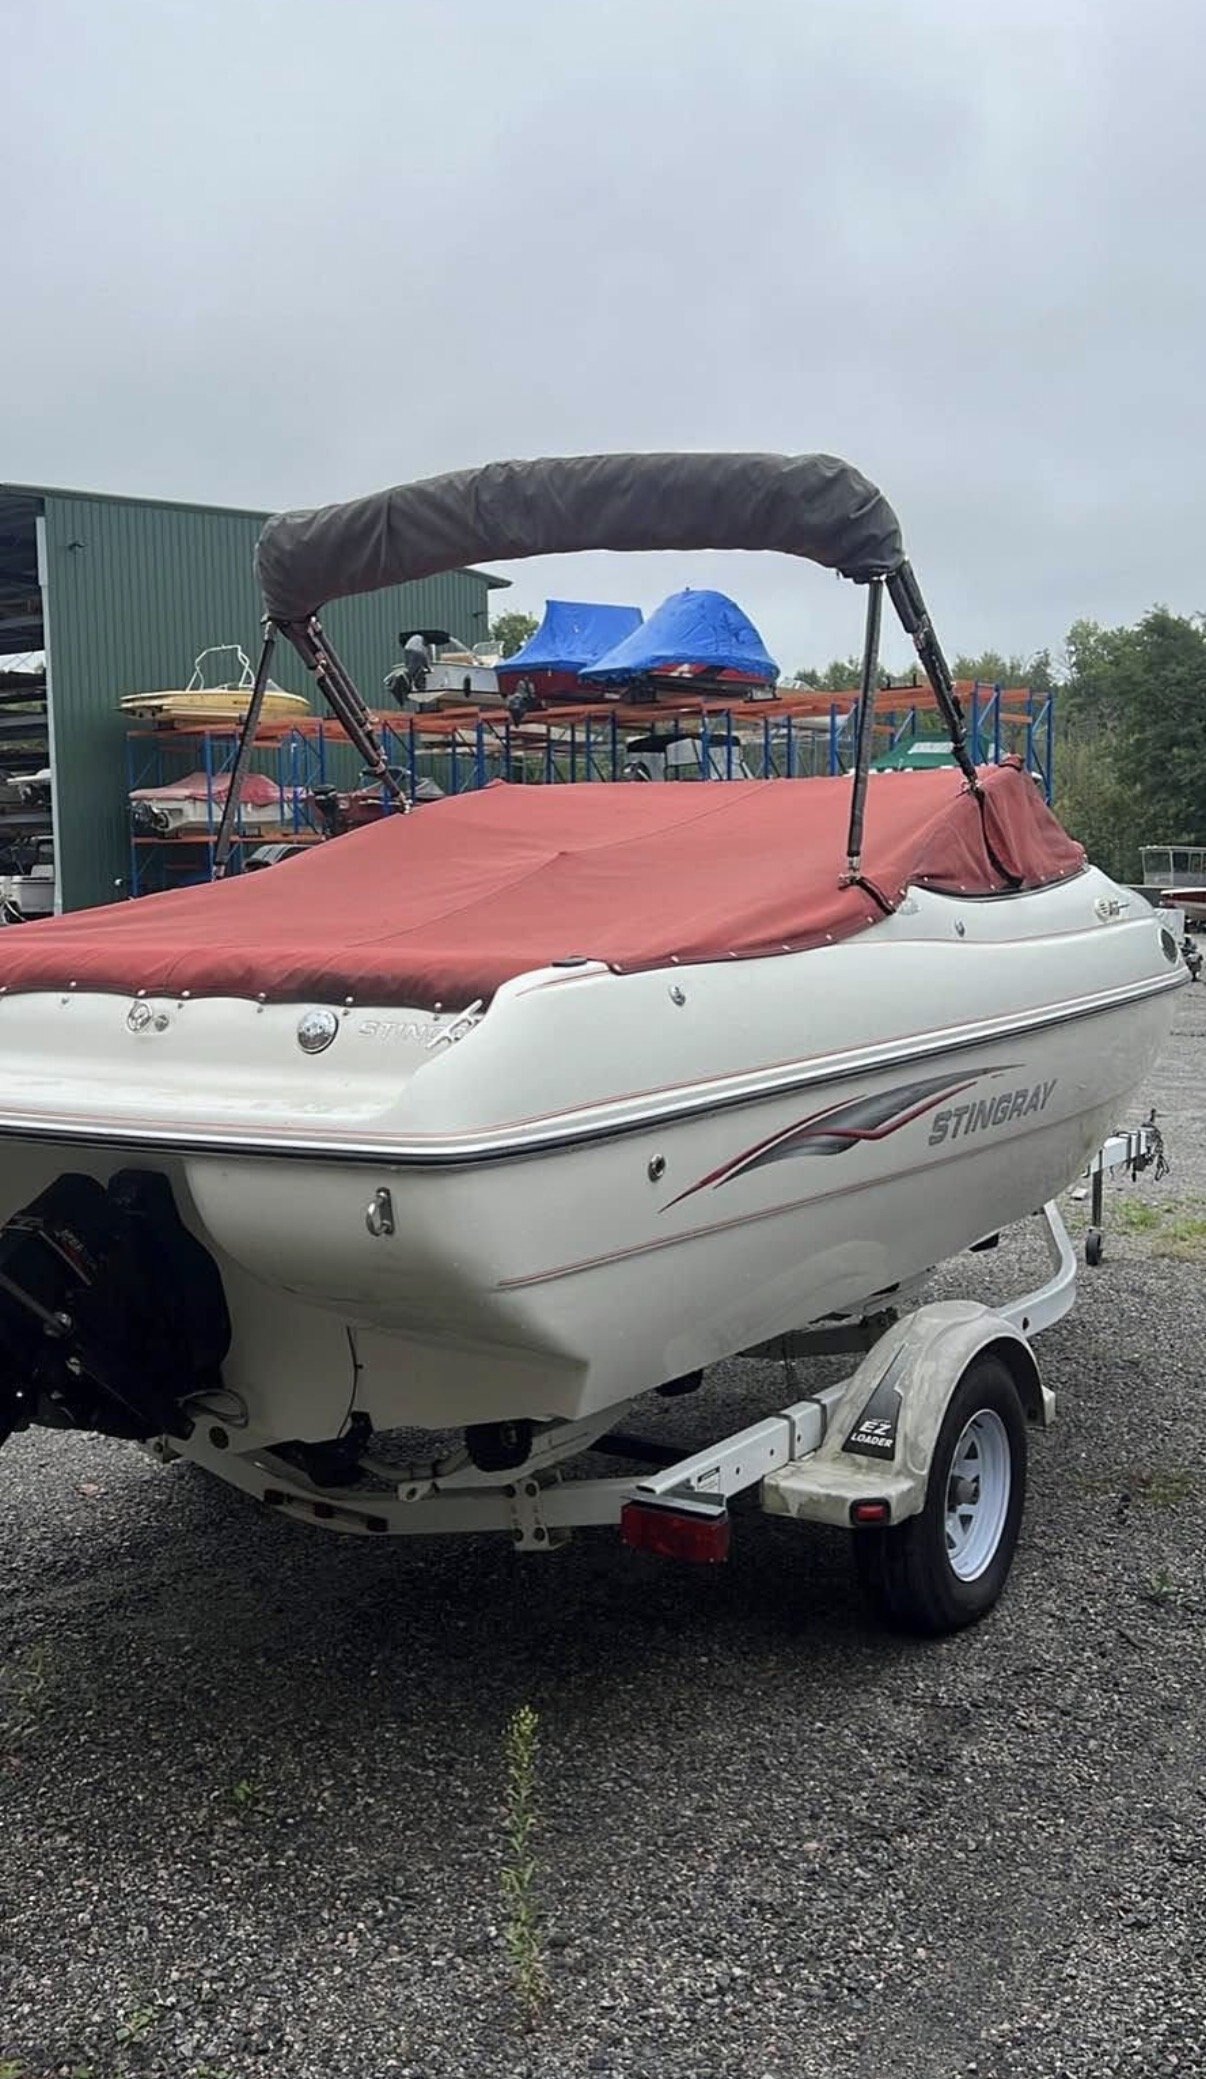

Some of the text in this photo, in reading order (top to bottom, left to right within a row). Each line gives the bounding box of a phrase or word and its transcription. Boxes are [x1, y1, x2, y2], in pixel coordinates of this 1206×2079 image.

[928, 1078, 1057, 1146] STINGRAY
[859, 1420, 892, 1435] EZ
[851, 1432, 893, 1447] LOADER
